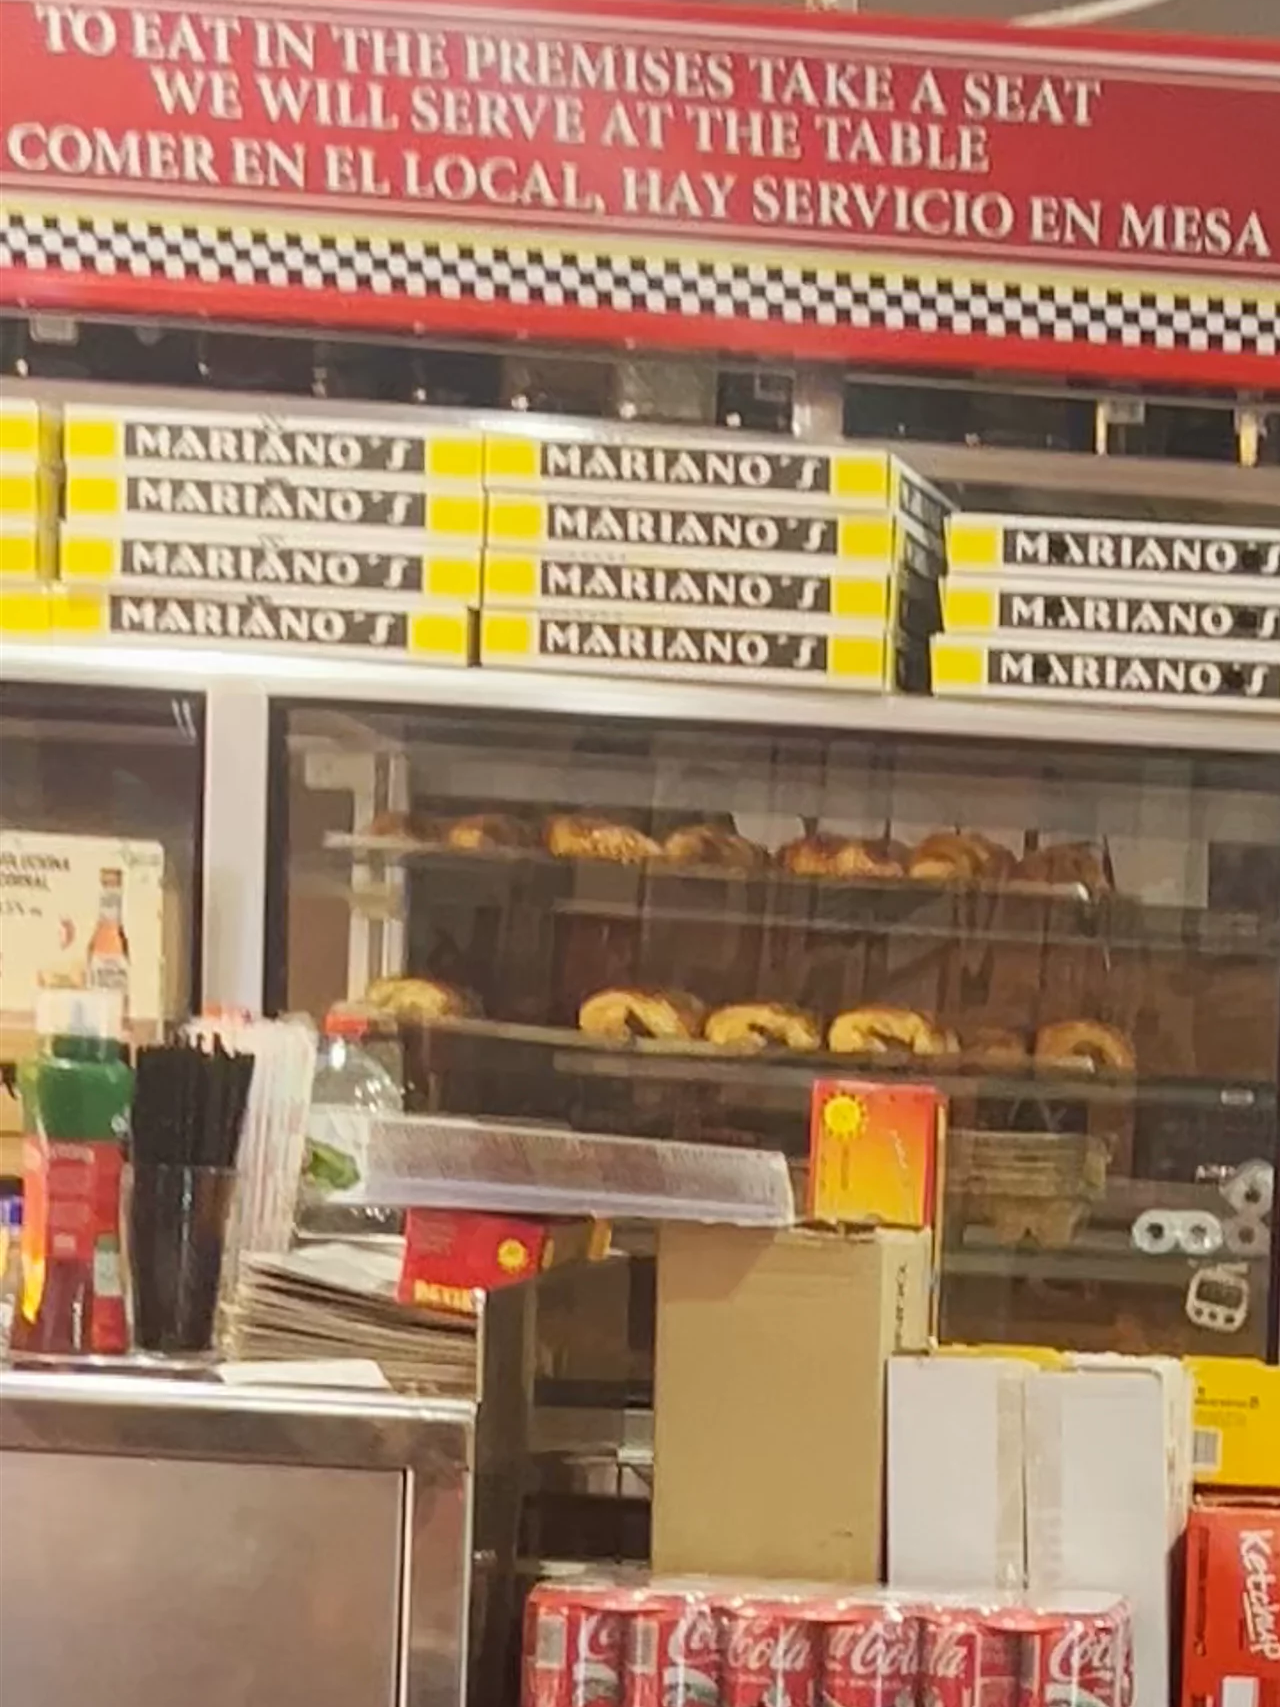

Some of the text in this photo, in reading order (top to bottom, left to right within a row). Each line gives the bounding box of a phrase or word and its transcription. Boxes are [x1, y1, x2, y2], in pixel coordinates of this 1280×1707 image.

[35, 2, 1102, 128] TO EAT IN THE PREMISES TAKE A SEAT
[151, 67, 990, 173] WE WILL SERVE AT THE TABLE
[8, 122, 1272, 259] COMER EN EL LOCAL, HAY SERVICIO EN MESA
